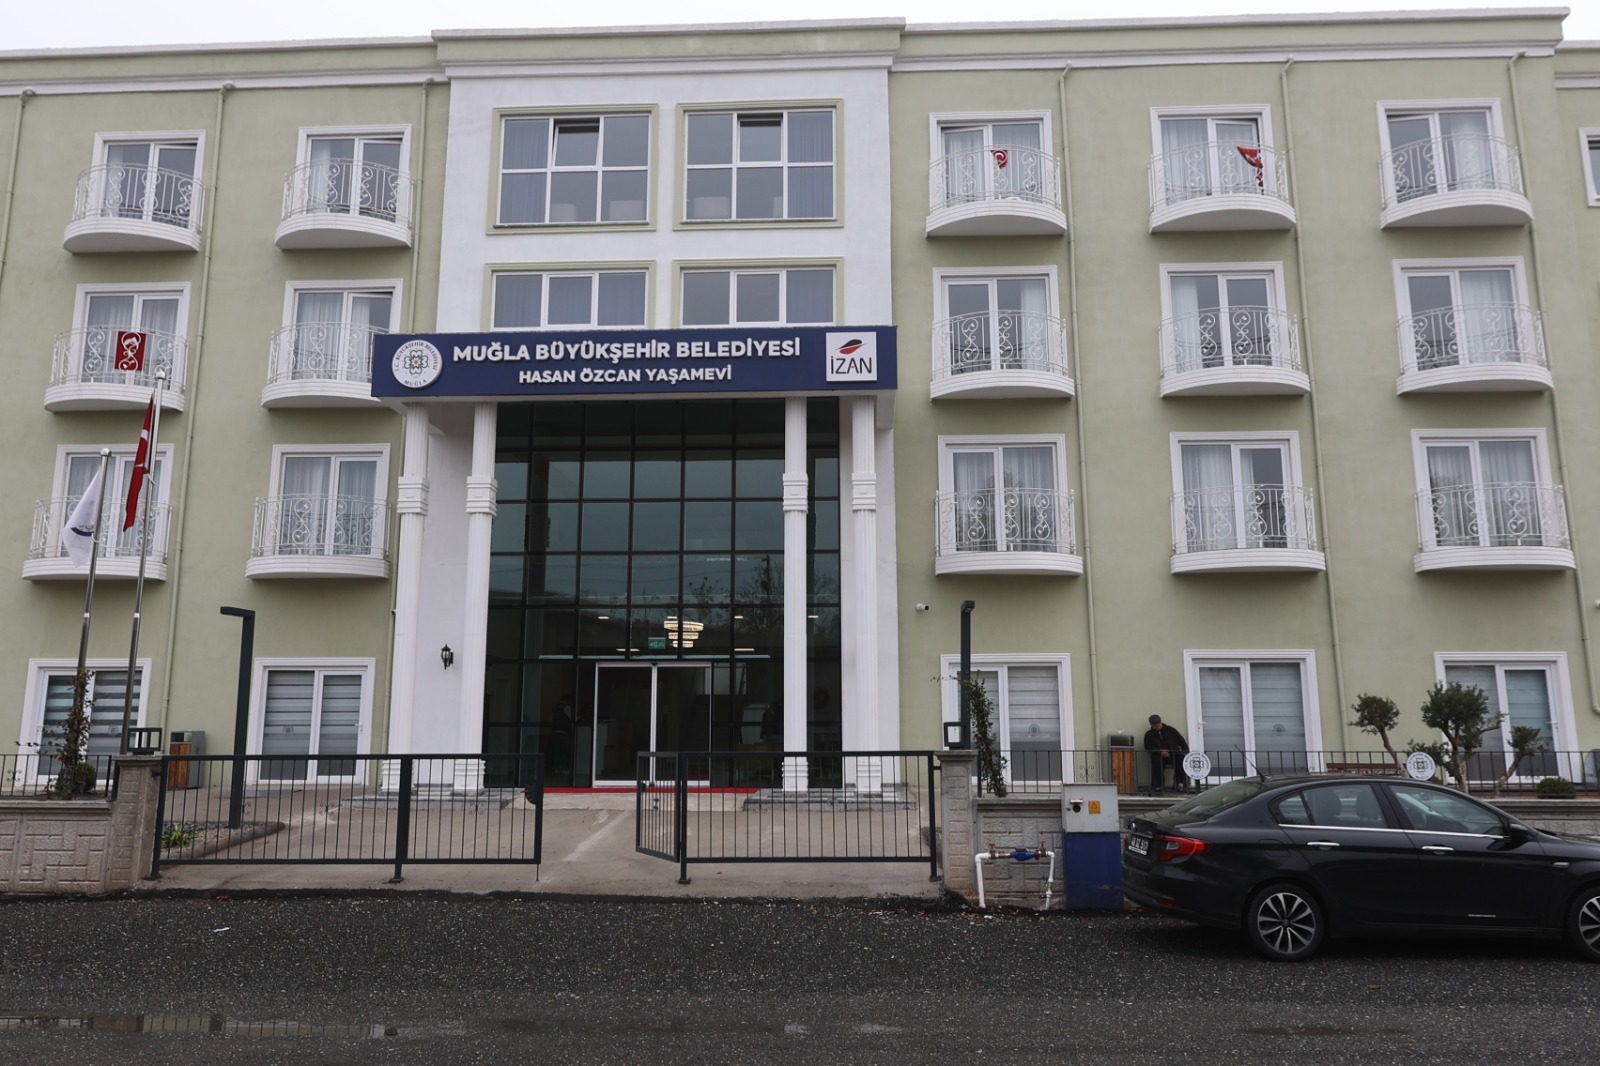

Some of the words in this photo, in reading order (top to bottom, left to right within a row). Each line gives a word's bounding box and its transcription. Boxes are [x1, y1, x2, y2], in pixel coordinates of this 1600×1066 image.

[453, 341, 531, 361] MUĞLA
[535, 340, 671, 364] BÜYÜKŞEHİR
[676, 337, 800, 358] BELEDİYESİ
[518, 370, 576, 384] HASAN
[579, 367, 641, 383] ÖZCAN
[645, 364, 732, 385] YAŞAMEVİ
[831, 355, 872, 374] İZAN
